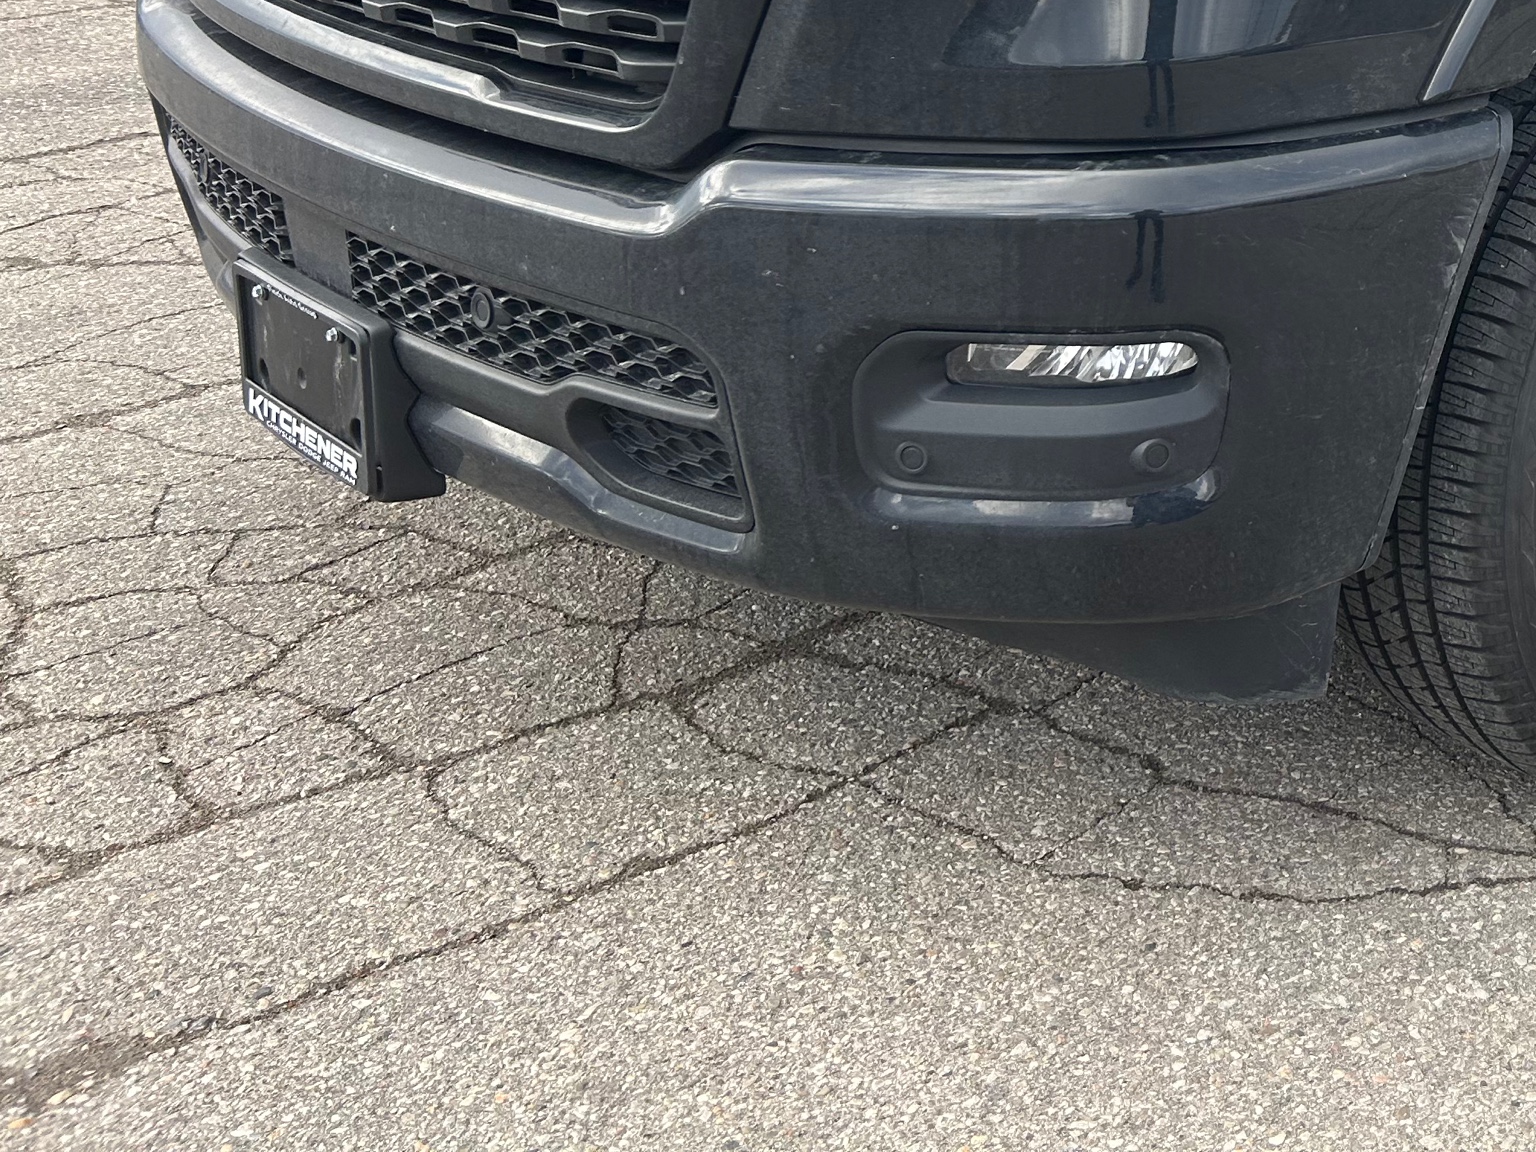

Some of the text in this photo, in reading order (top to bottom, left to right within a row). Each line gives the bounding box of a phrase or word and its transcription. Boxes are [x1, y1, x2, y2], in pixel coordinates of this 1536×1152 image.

[247, 386, 358, 480] KITCHENER
[265, 419, 357, 486] CHRYSLER DODGE JEEP RAM
